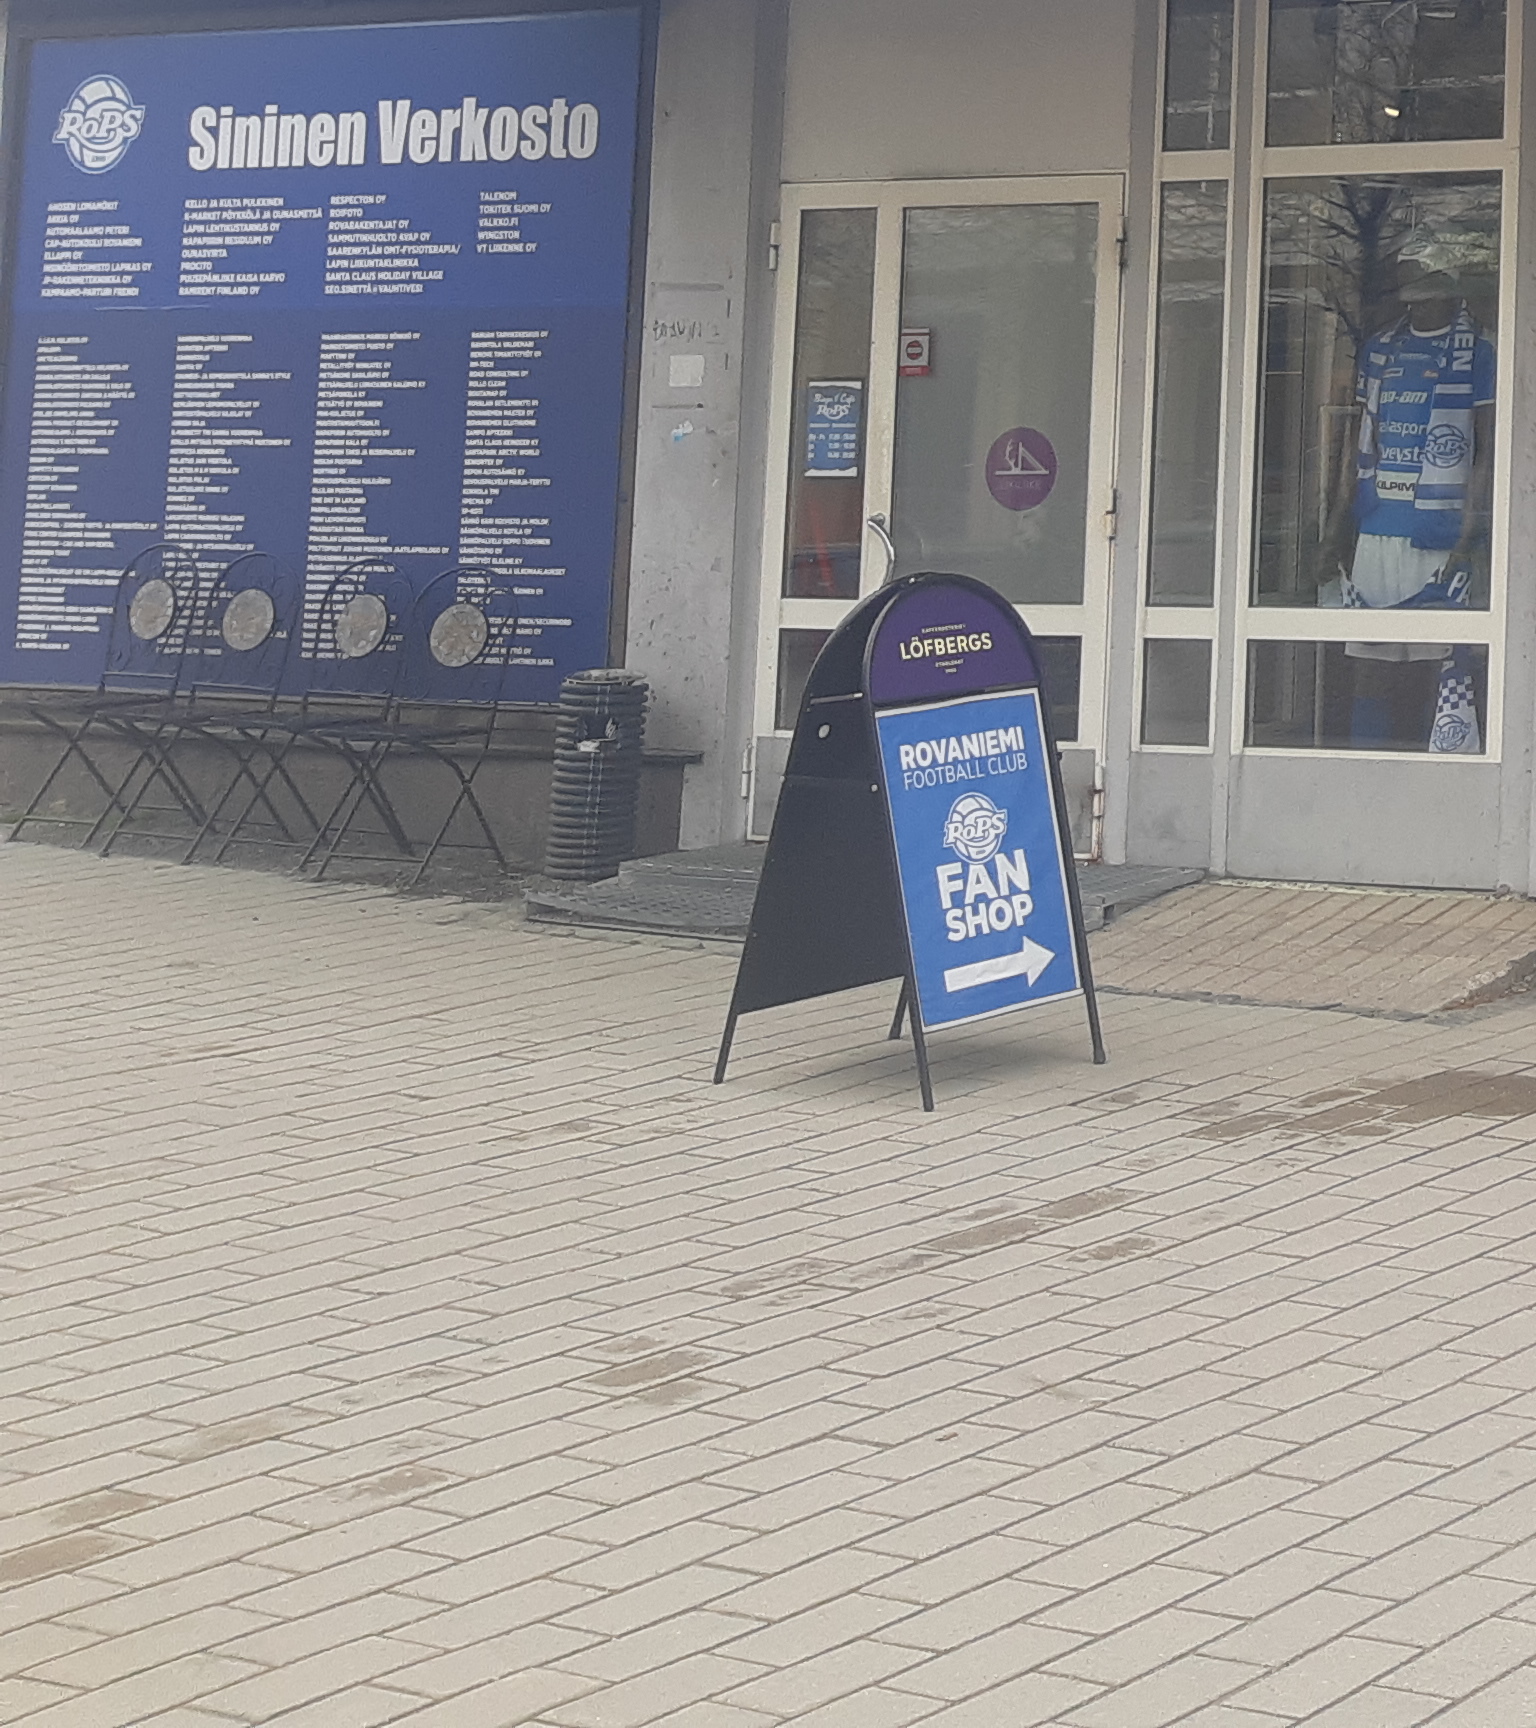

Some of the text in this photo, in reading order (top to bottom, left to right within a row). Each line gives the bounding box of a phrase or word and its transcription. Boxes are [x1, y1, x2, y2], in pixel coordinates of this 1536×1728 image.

[56, 107, 144, 153] RoPS
[188, 97, 599, 172] Sininen Verkosto
[899, 632, 993, 660] LÖFBERGS
[900, 726, 1025, 771] ROVANIEMI
[903, 752, 1028, 791] FOOTBALL CLUB
[943, 808, 1008, 847] RoPS
[935, 848, 1031, 910] FAN
[945, 892, 1034, 942] SHOP
